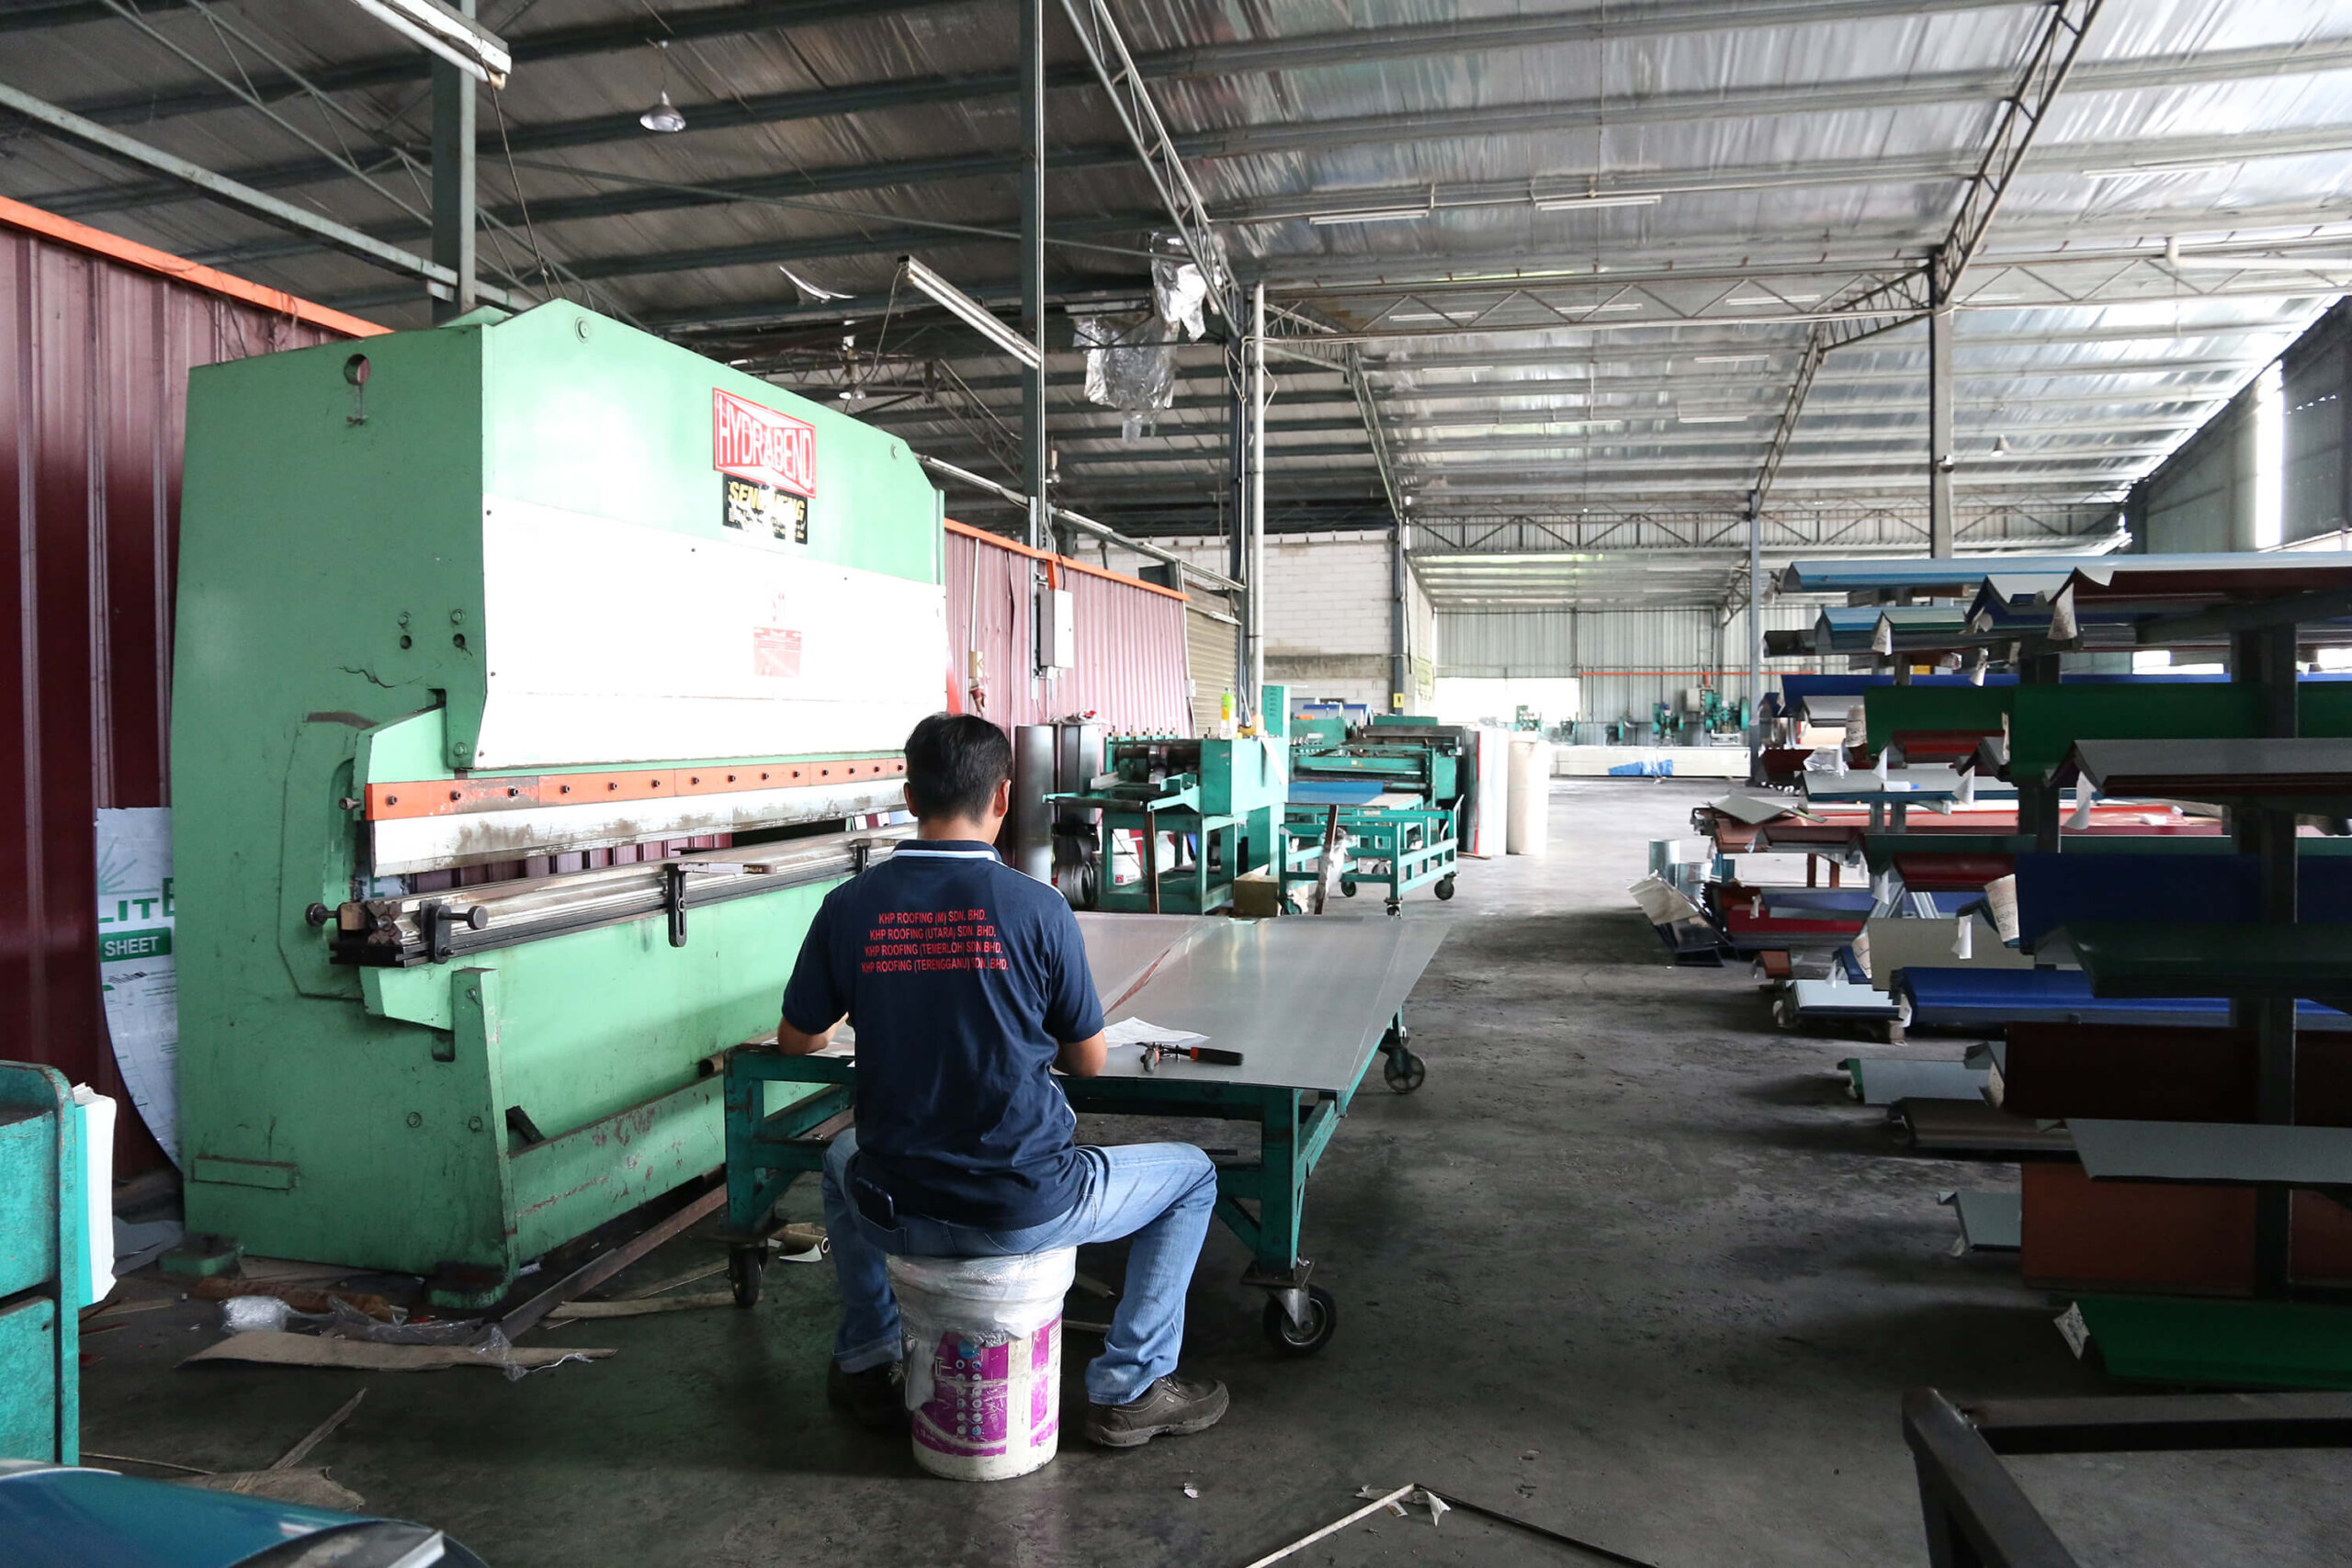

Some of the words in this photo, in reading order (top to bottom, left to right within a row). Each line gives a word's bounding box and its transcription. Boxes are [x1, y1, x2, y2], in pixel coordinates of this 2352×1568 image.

[718, 395, 813, 490] HYDRABEND
[878, 912, 896, 924] KHP
[897, 912, 933, 924] ROOFING
[968, 908, 988, 920] BHD.
[869, 929, 887, 941] KHP
[888, 928, 923, 940] ROOFING
[925, 926, 956, 941] (UTARA)
[977, 925, 997, 937] BHD.
[105, 936, 158, 957] SHEET
[865, 944, 880, 957] KHP
[881, 943, 918, 955] ROOFING
[861, 962, 875, 973] KHP
[876, 960, 912, 972] ROOFING
